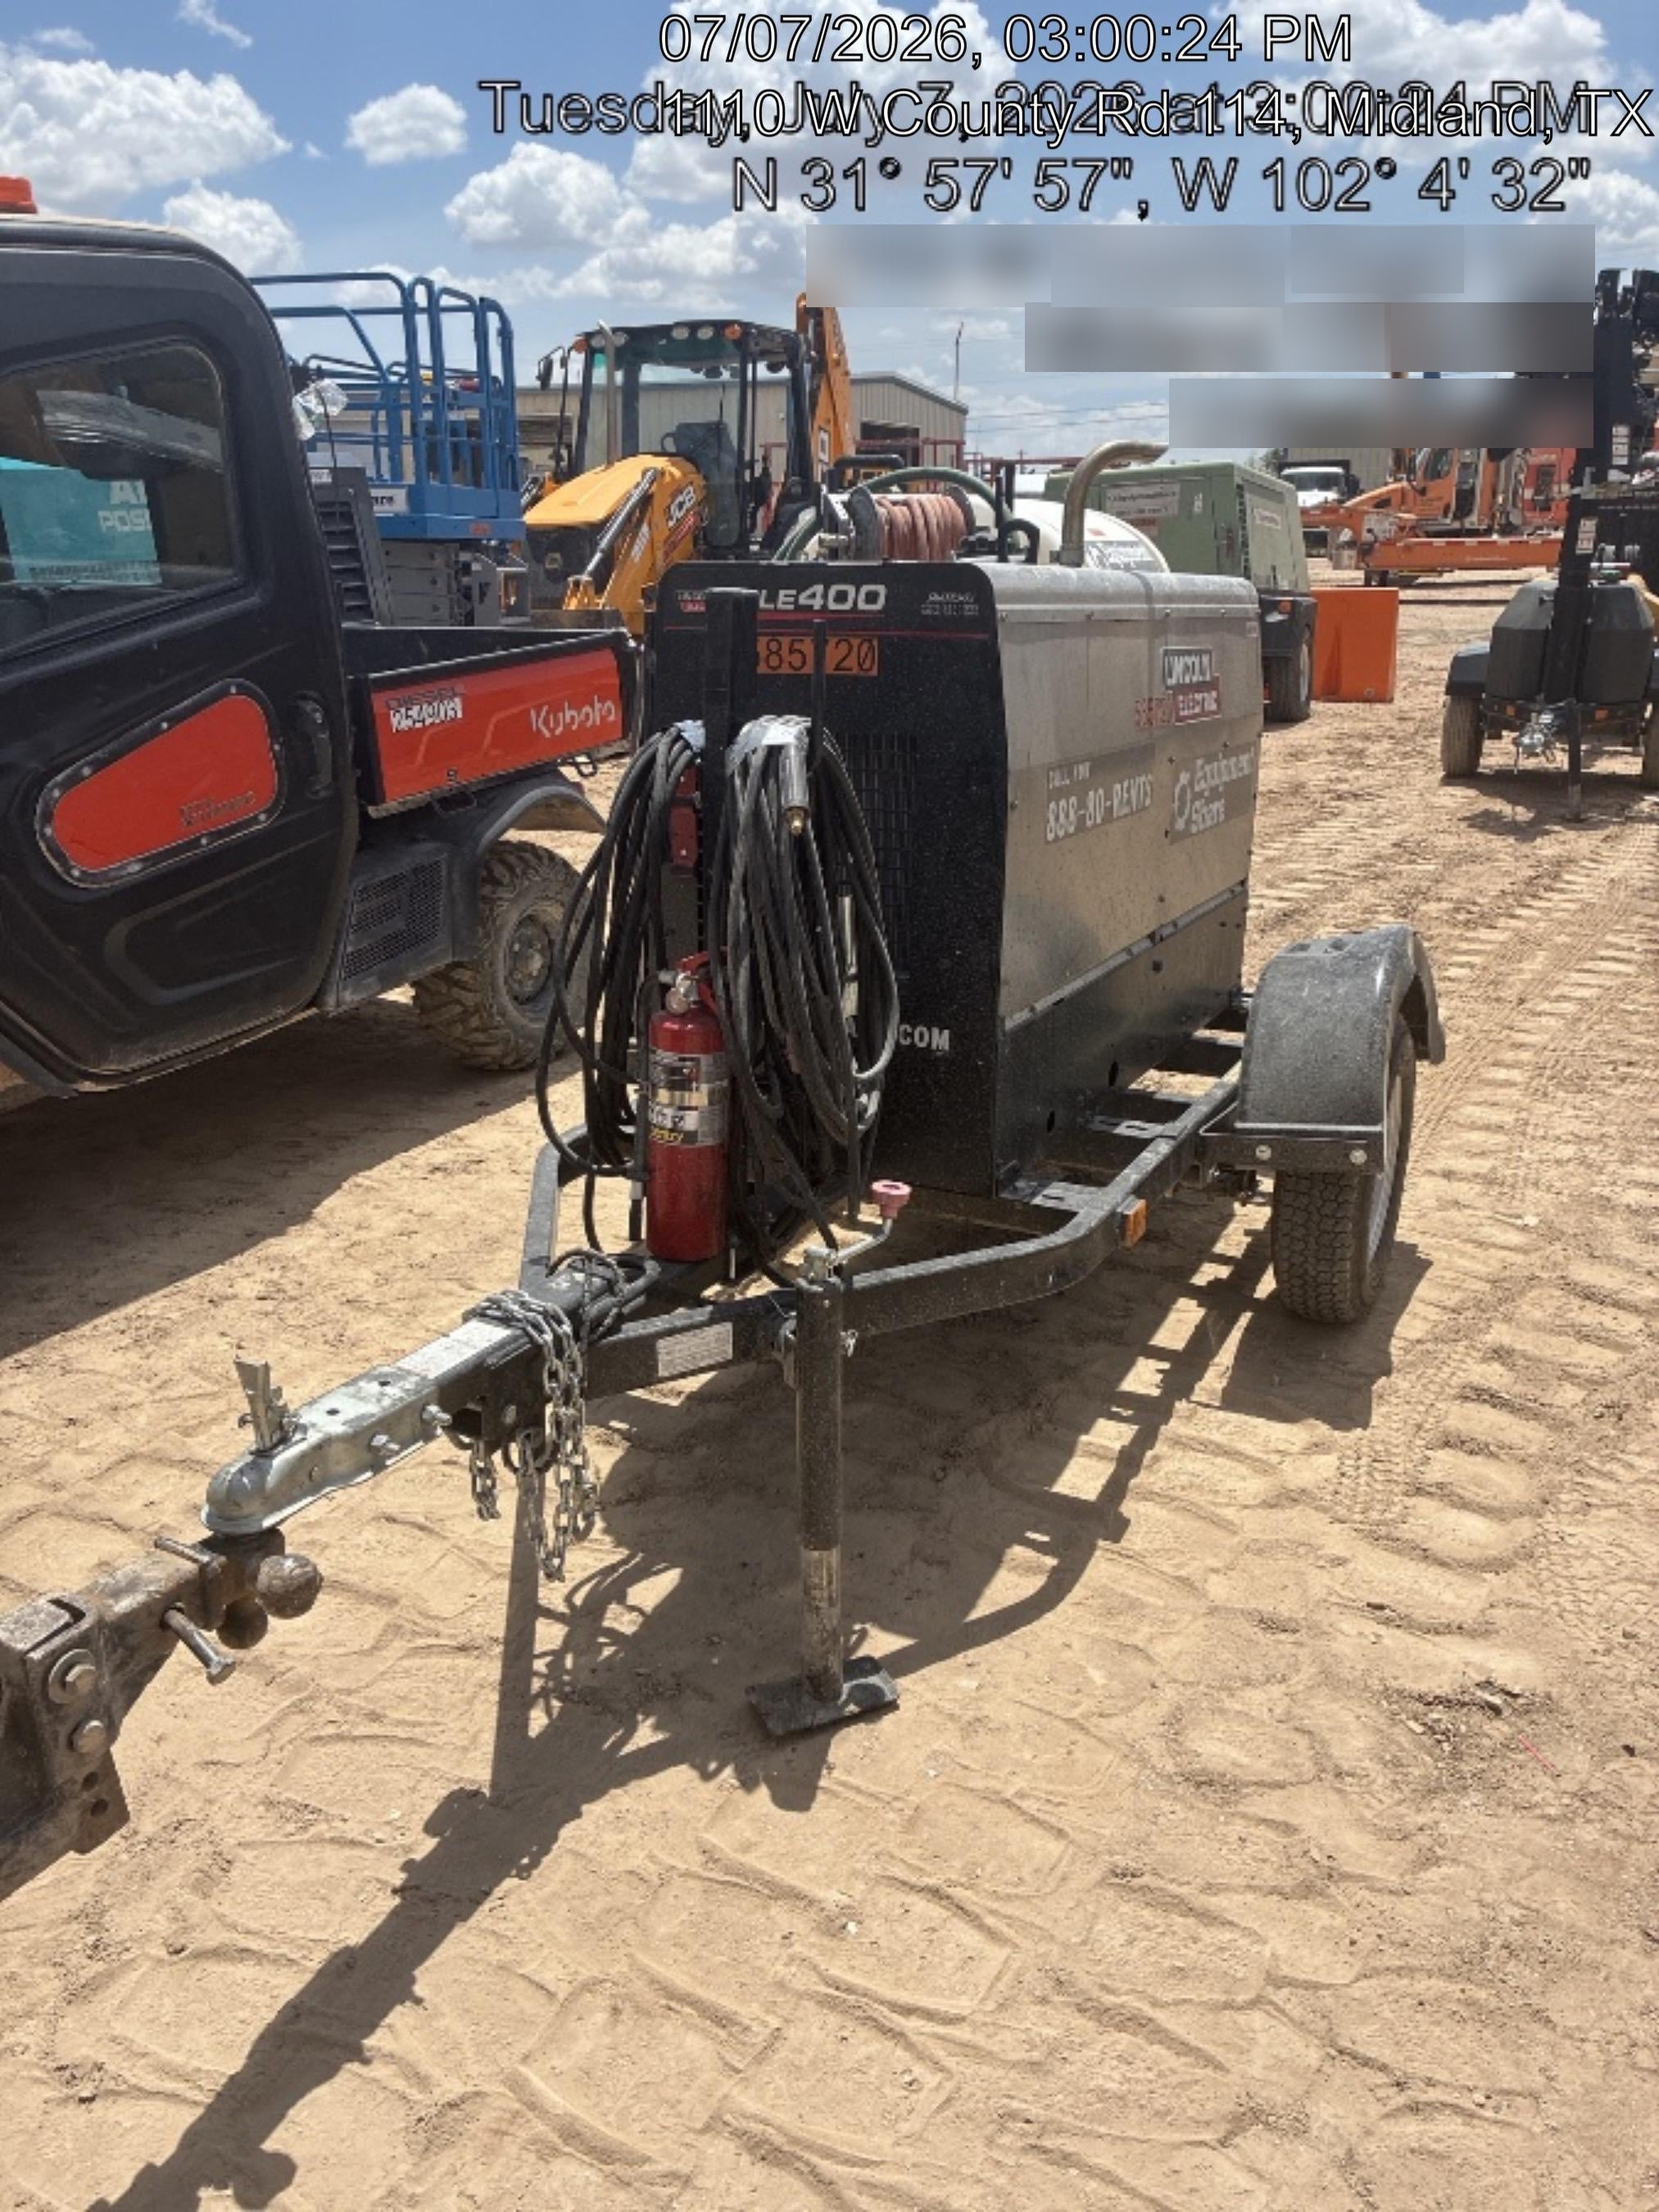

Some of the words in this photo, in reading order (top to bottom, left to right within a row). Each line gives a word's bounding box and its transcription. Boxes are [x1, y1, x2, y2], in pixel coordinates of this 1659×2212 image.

[668, 483, 696, 528] JCB
[756, 637, 877, 673] 8520
[1164, 653, 1211, 687] LINCOLN
[530, 695, 616, 738] Kubota
[1194, 746, 1254, 797] Equipment
[1191, 799, 1226, 834] Share
